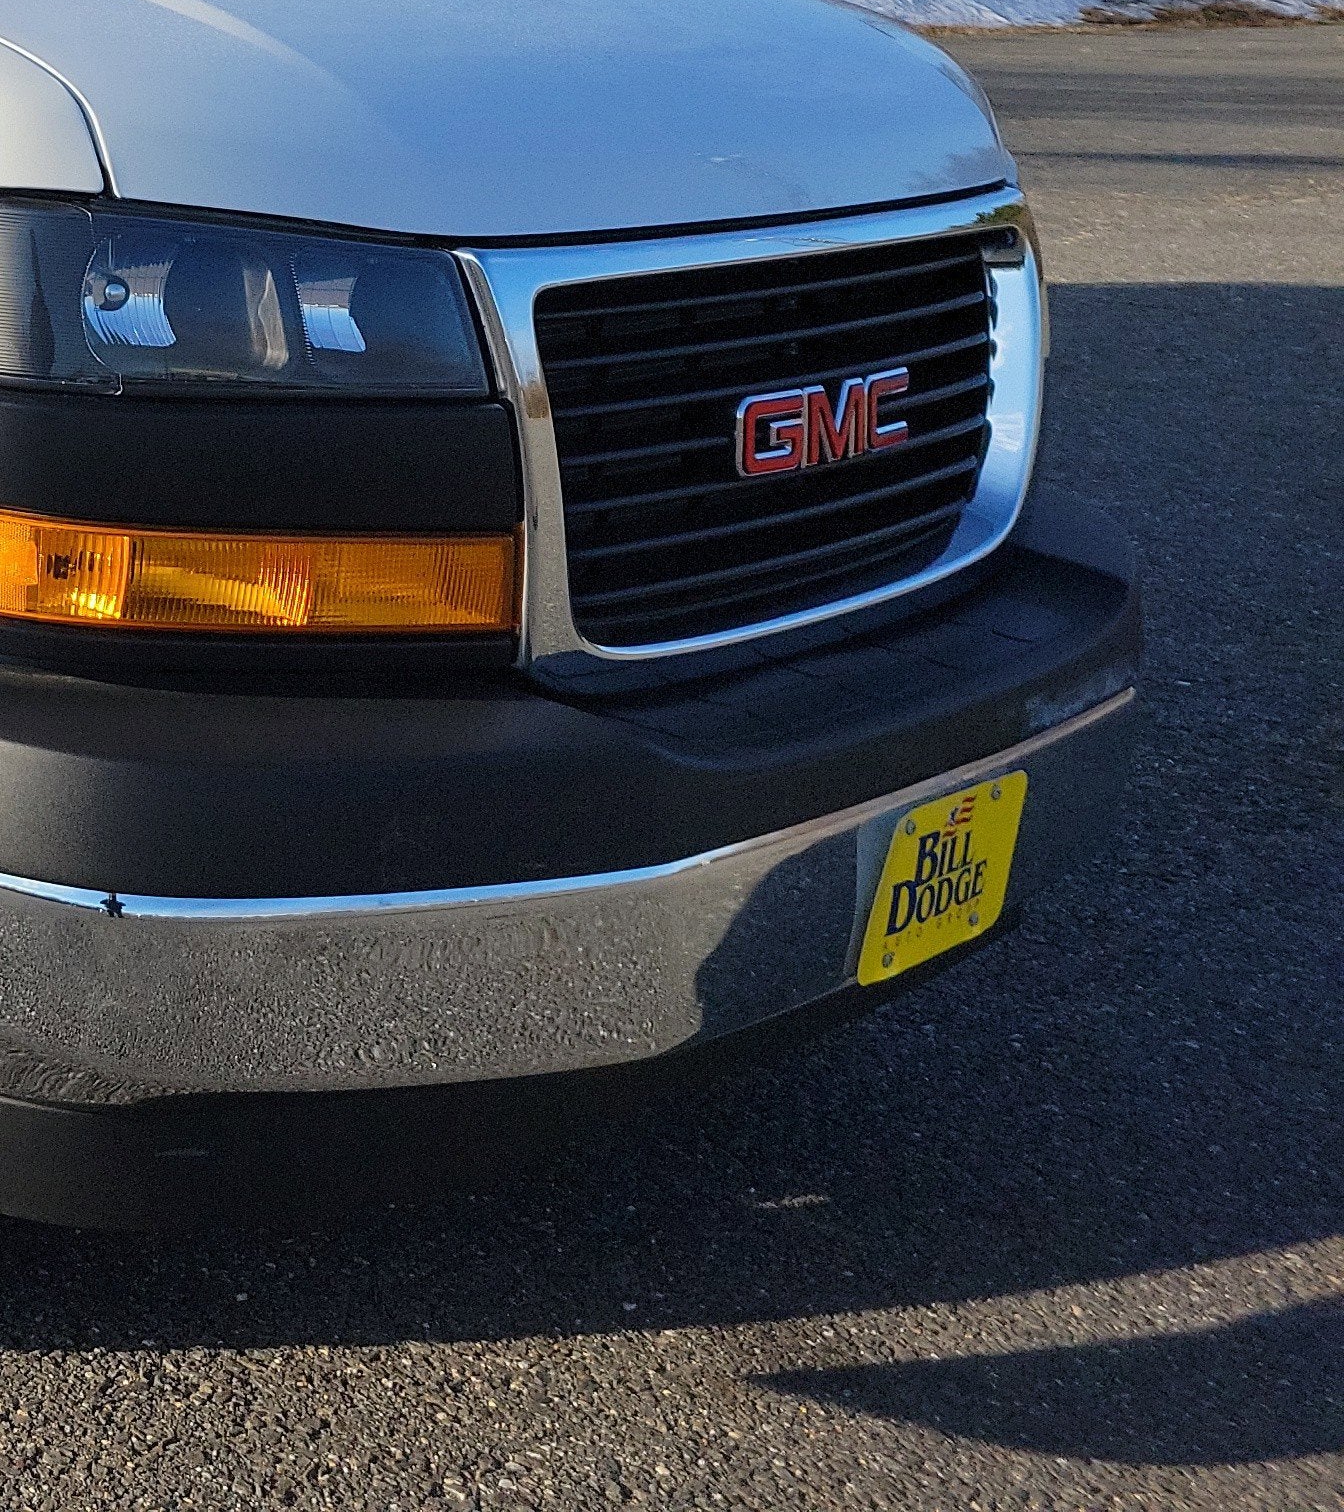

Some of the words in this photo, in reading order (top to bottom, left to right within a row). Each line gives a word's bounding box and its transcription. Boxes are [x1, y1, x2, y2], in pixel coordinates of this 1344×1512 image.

[735, 366, 910, 477] GMC
[883, 858, 988, 937] DODGE
[913, 829, 974, 887] BILL
